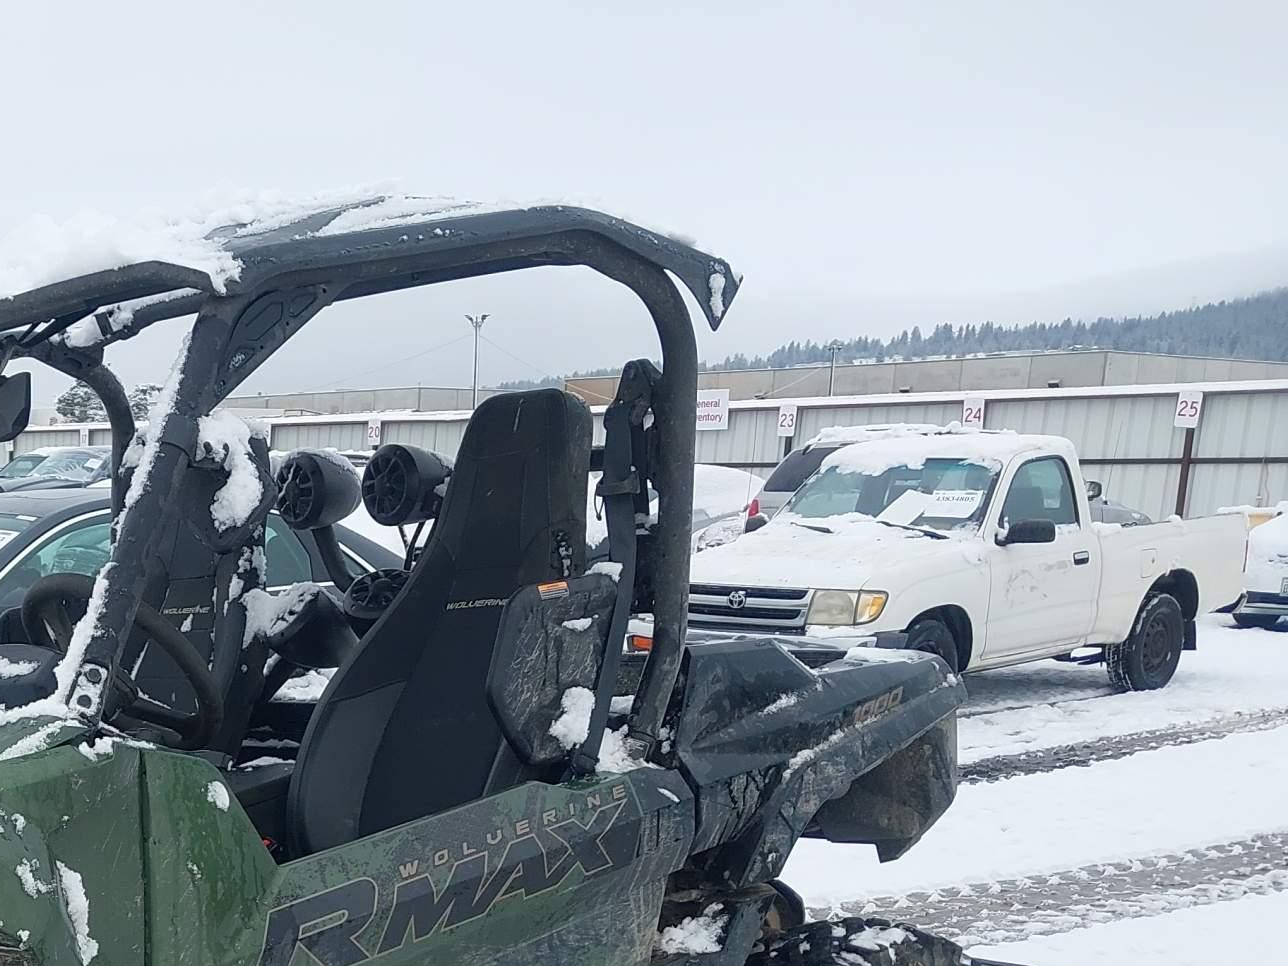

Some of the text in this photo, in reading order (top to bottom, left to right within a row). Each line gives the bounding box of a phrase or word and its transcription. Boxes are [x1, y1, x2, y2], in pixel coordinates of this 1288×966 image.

[696, 399, 721, 409] eneral
[1177, 400, 1199, 418] 25
[696, 413, 723, 423] entory
[779, 413, 795, 428] 23
[964, 407, 982, 423] 24
[368, 425, 381, 439] 20
[854, 686, 904, 723] 1000
[399, 783, 627, 878] WOLVERINE
